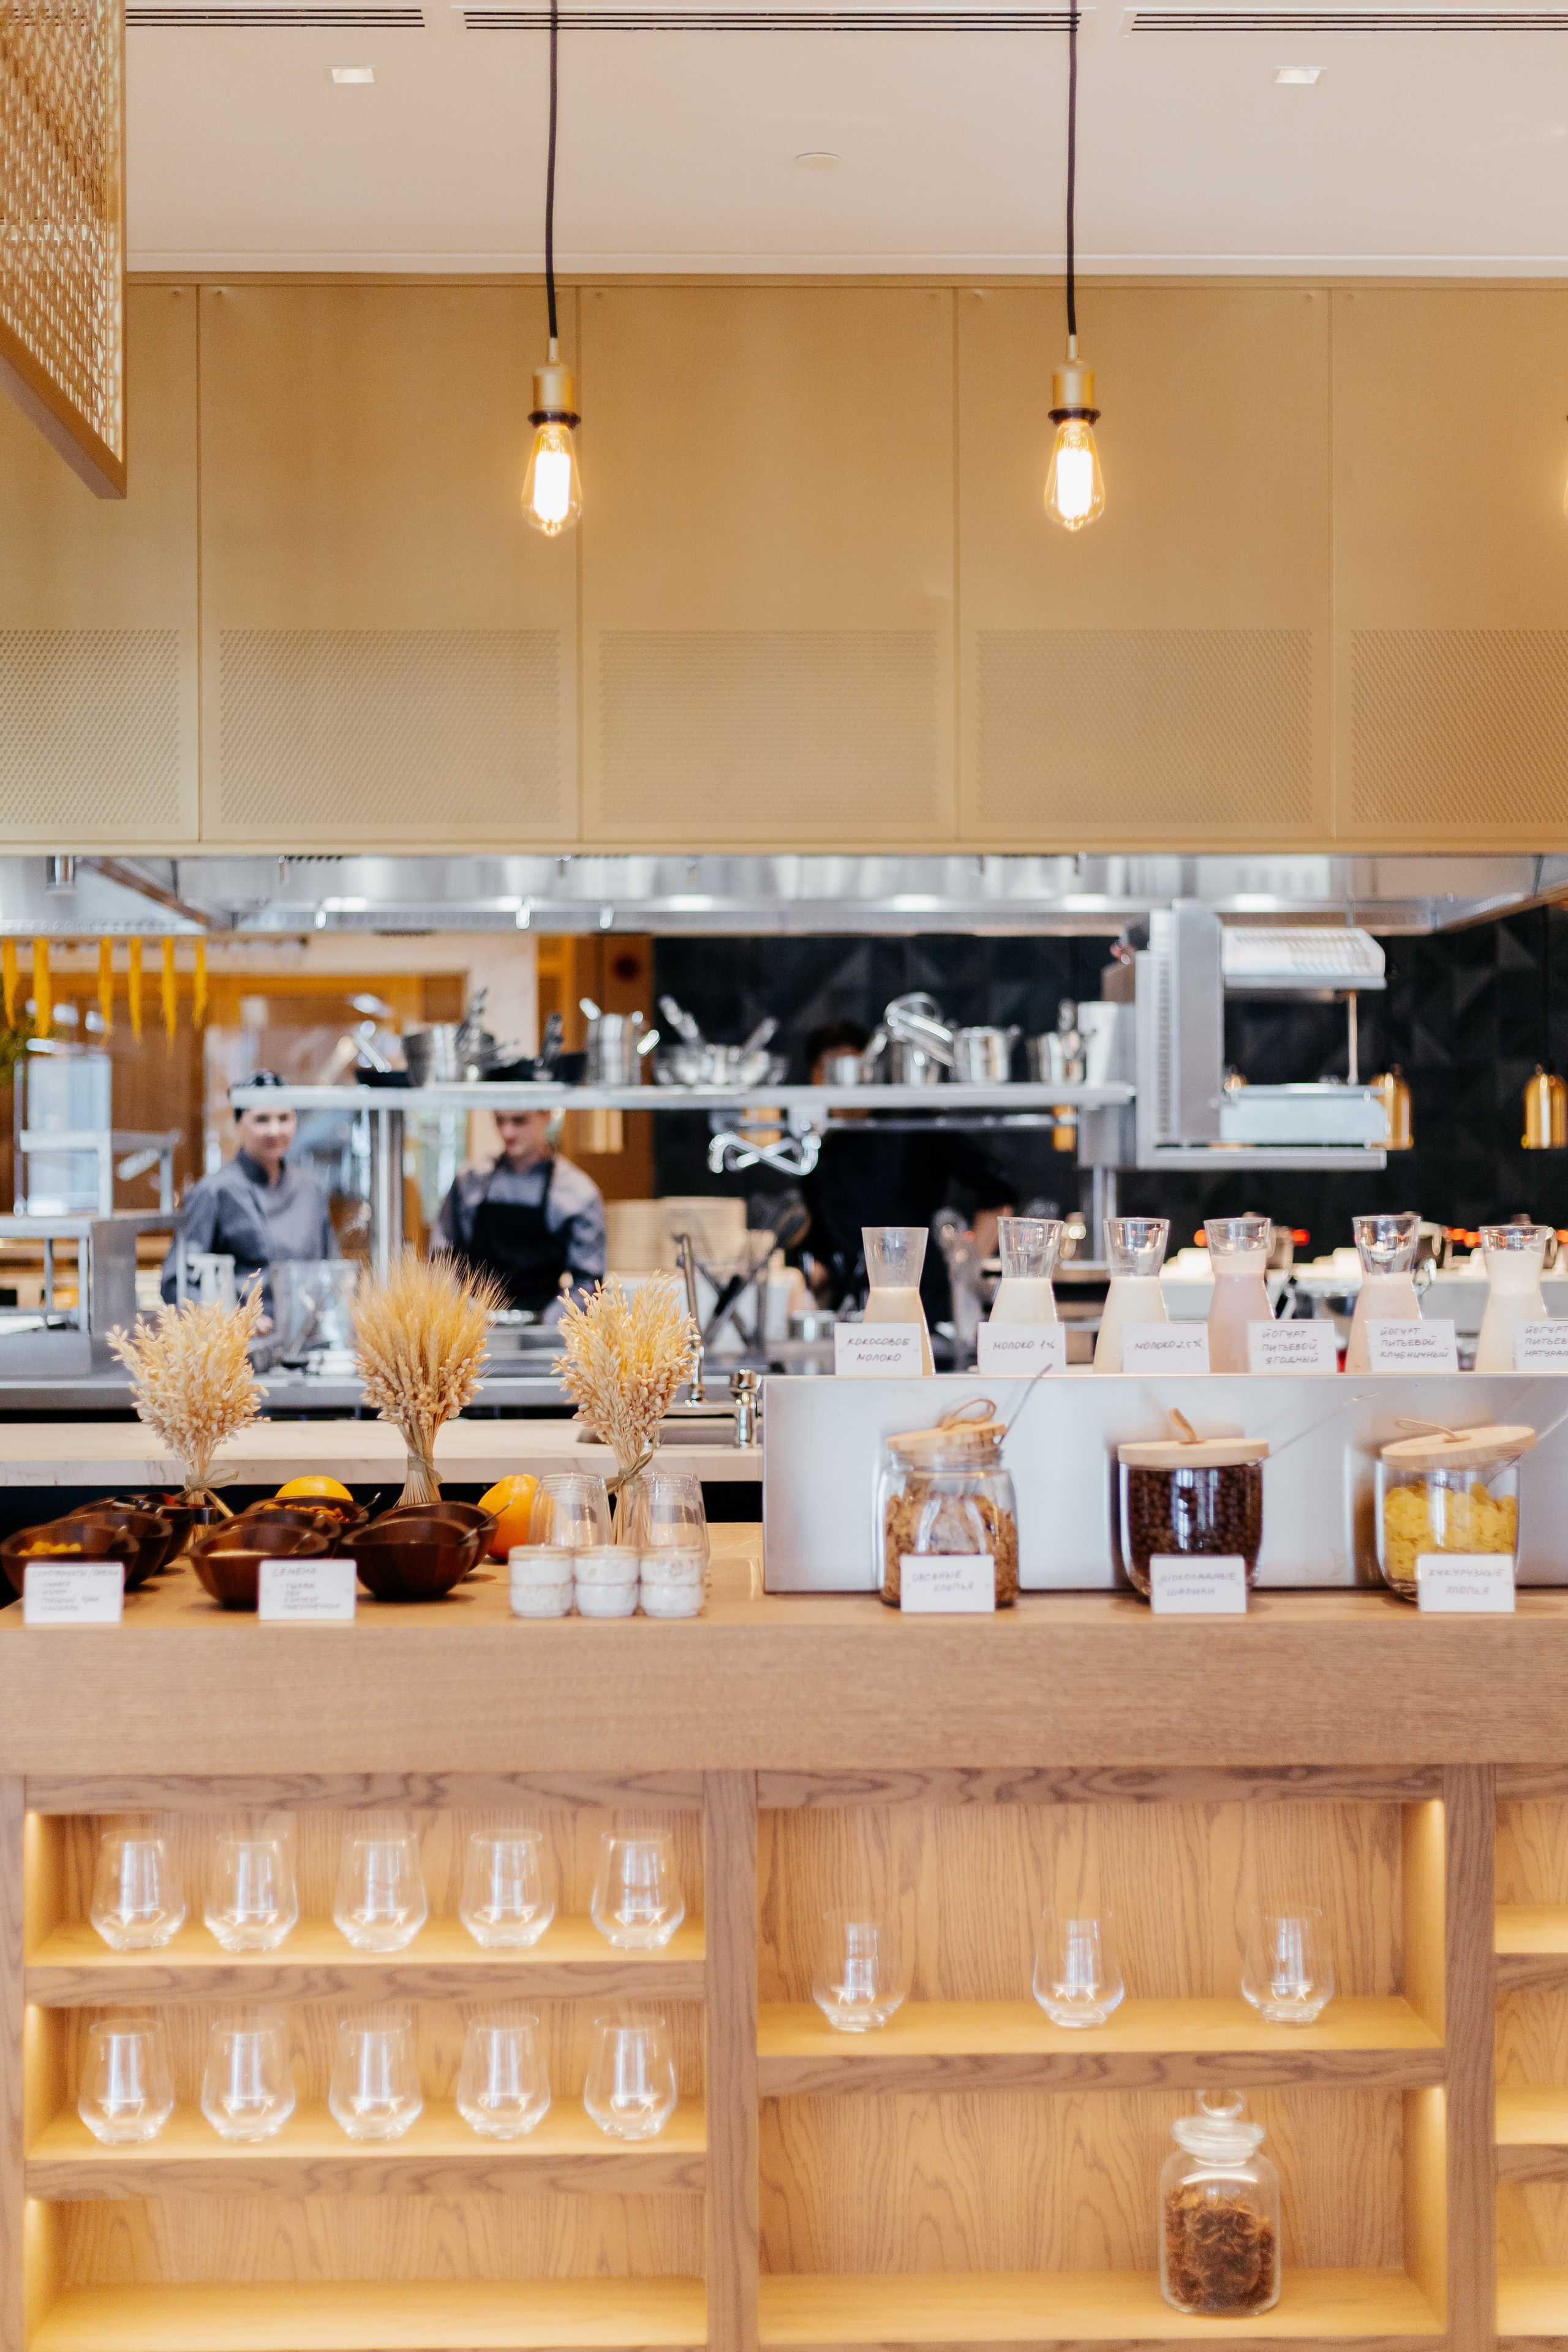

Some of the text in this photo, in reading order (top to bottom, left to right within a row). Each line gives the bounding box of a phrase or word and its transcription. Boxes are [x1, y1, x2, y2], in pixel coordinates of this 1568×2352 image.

[1262, 1329, 1308, 1338] ЙОГУРТ
[1380, 1327, 1422, 1336] ЙОГУРТ
[1525, 1325, 1568, 1334] ЙОГУРТ
[992, 1340, 1035, 1351] МОЛОКО
[1134, 1340, 1176, 1350] МОЛОКО
[1261, 1339, 1318, 1352] ПИТЬЕВОЙ
[1381, 1335, 1438, 1347] ПИТЬЕВОЙ
[856, 1353, 902, 1362] МОЛОКО
[1380, 1347, 1449, 1359] КЛУБНИЧНЫЙ
[1265, 1352, 1319, 1365] ЯГОДНЫЙ
[272, 1567, 317, 1578] СЕМЕНА
[1161, 1572, 1237, 1583] ШОКОЛАДНЫЕ
[1429, 1568, 1506, 1578] КУКУРУЗНЫЕ
[933, 1581, 974, 1593] ХЛОПЬЯ
[1166, 1587, 1215, 1597] ШАРИКИ
[1445, 1586, 1490, 1596] ХЛОПЬЯ
